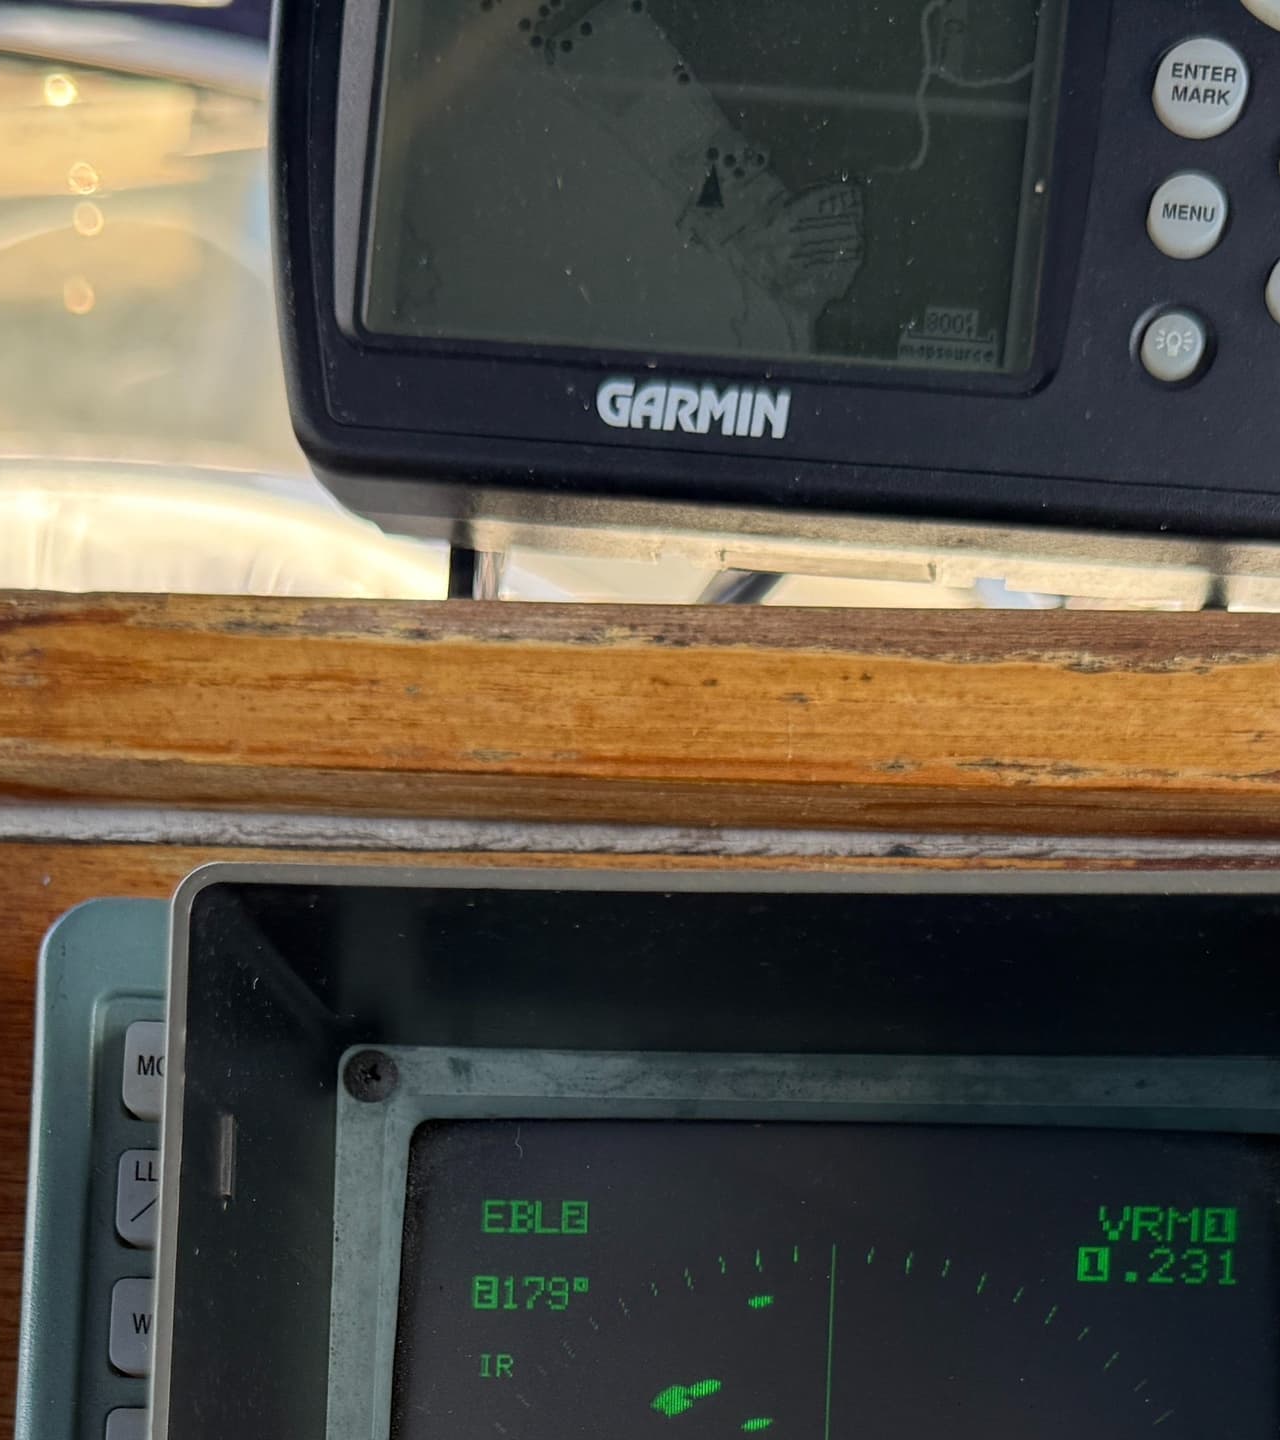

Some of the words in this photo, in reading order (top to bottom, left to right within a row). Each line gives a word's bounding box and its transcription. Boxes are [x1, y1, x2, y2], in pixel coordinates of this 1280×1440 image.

[1171, 62, 1238, 83] ENTER
[1171, 86, 1231, 106] MARK
[1161, 203, 1216, 223] MENU
[596, 379, 792, 440] GARMIN
[480, 1353, 514, 1378] IR
